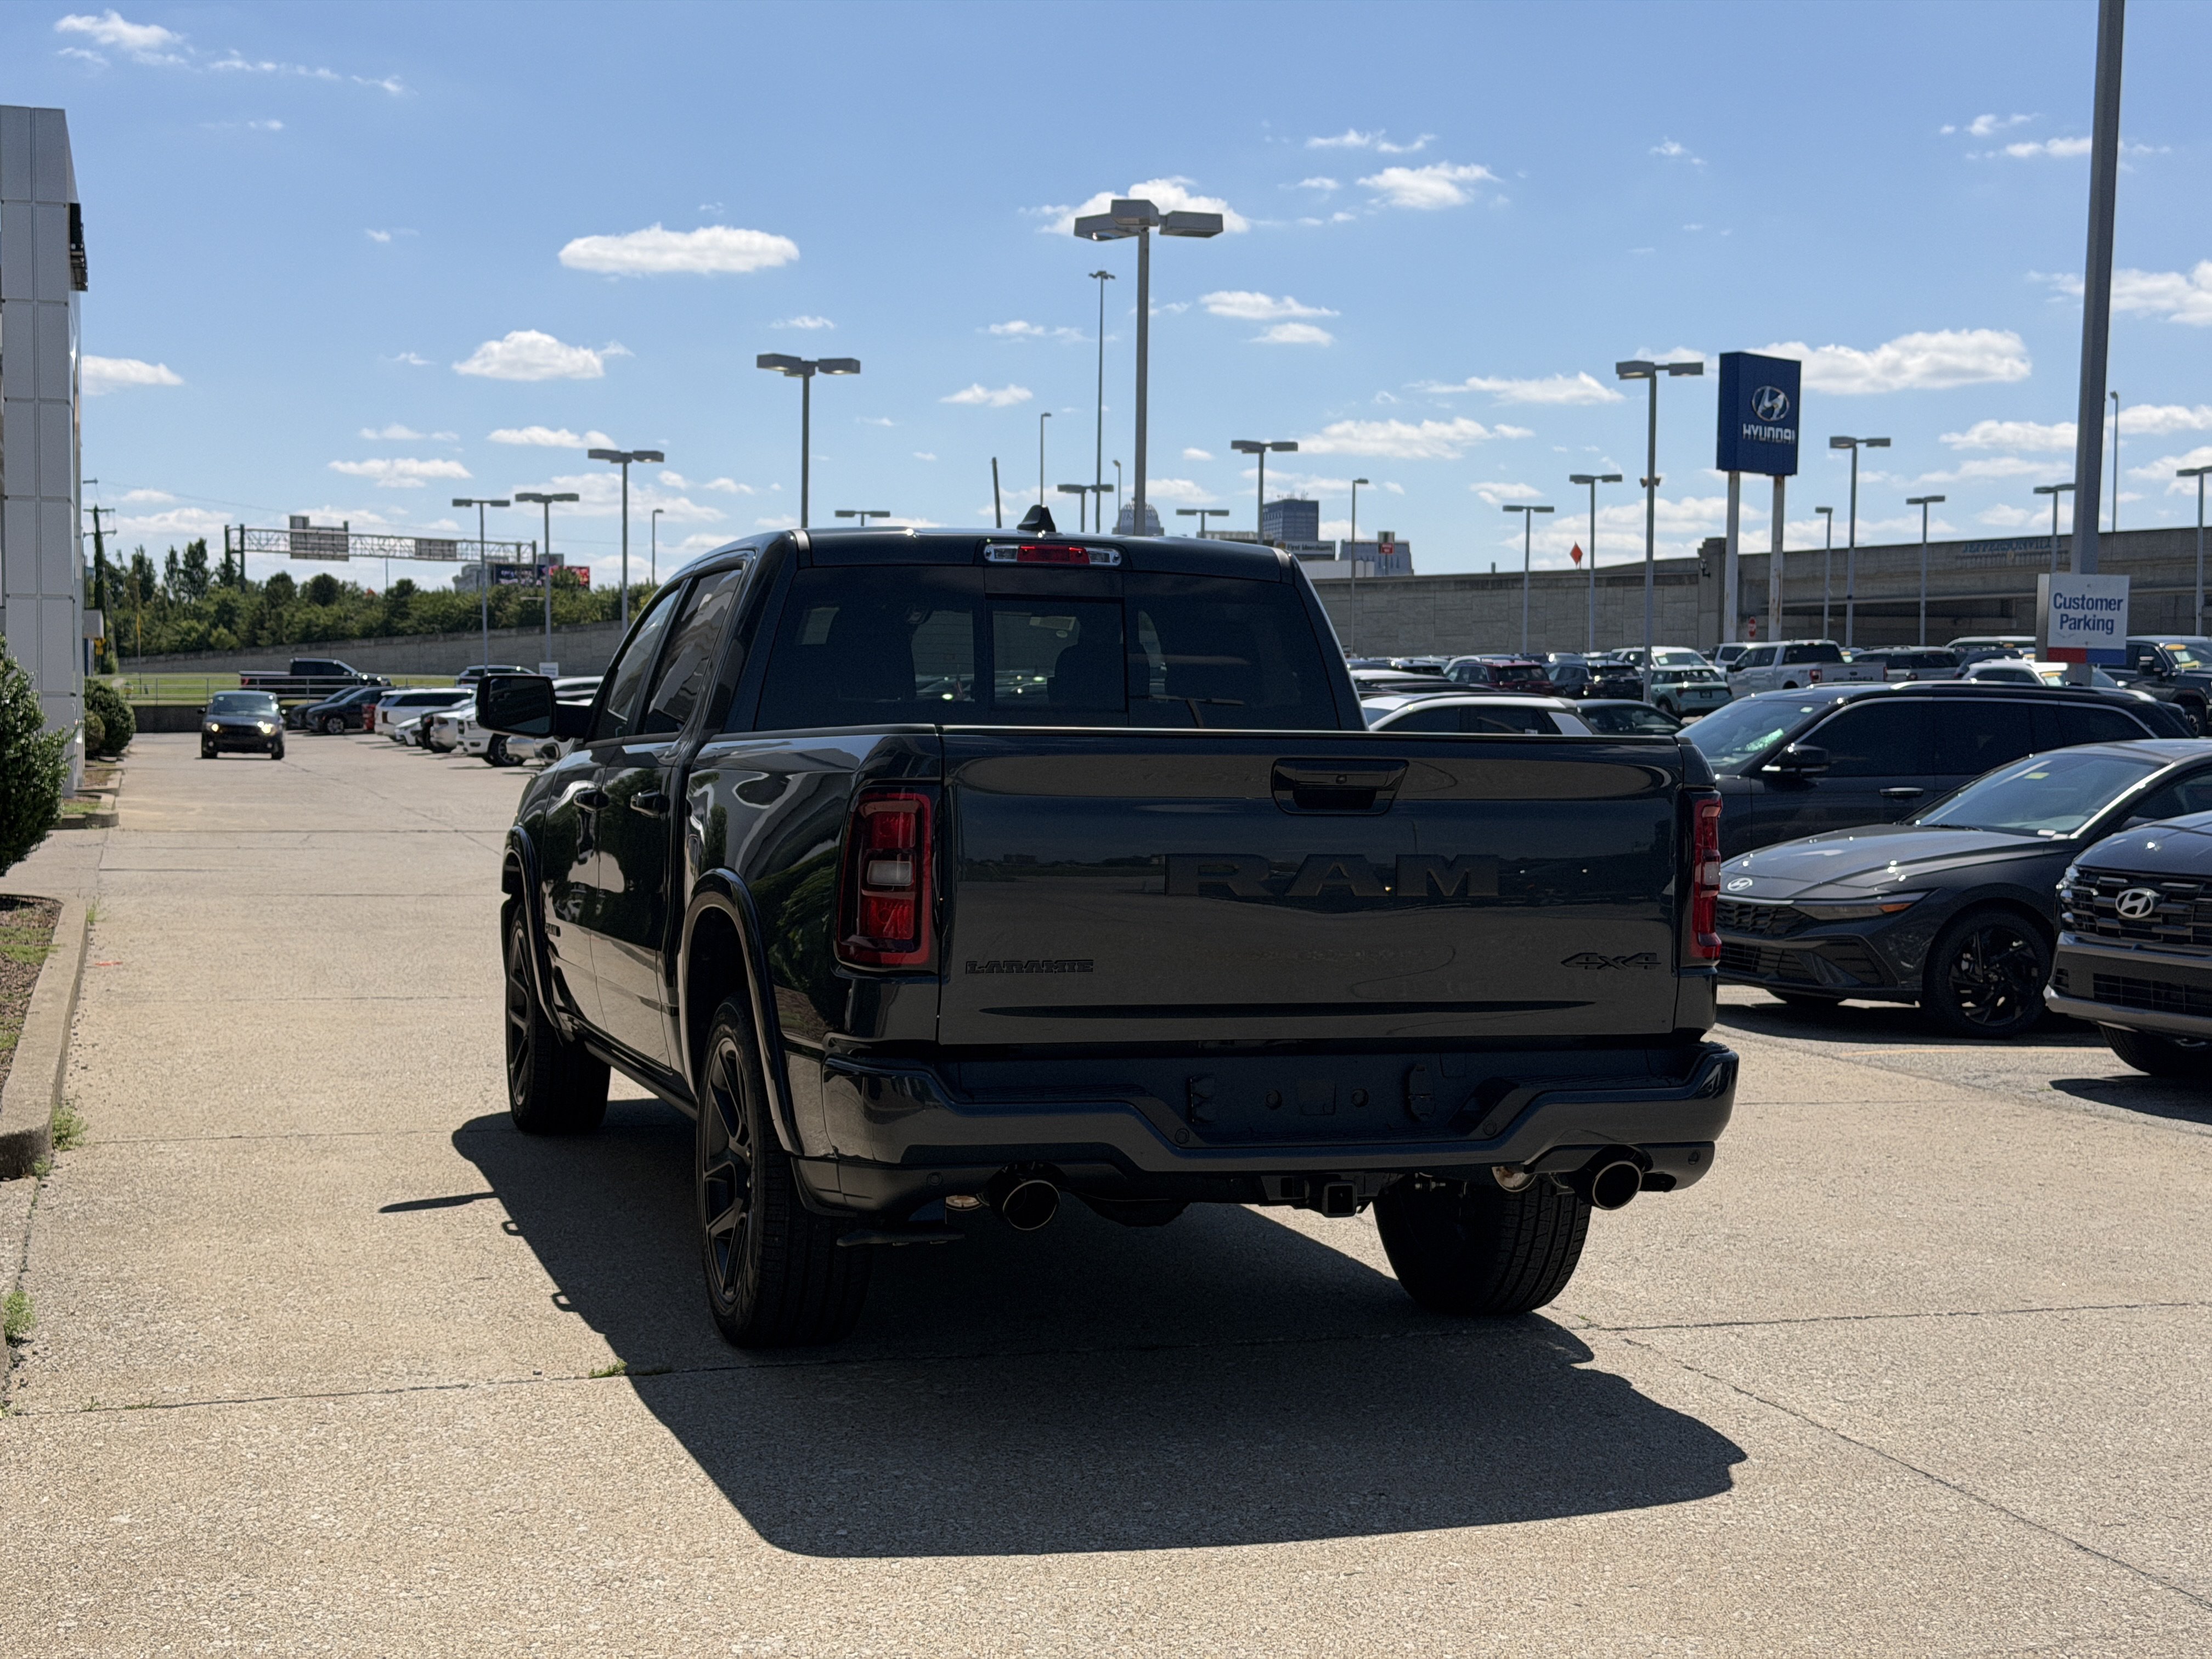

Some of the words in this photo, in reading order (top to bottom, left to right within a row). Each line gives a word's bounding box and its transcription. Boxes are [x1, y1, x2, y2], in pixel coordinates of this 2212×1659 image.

[1743, 424, 1796, 445] HYUNDAI
[2053, 592, 2124, 611] Customer
[2059, 613, 2114, 635] Parking
[1164, 853, 1499, 896] RAM
[966, 959, 1094, 974] LARAMIE
